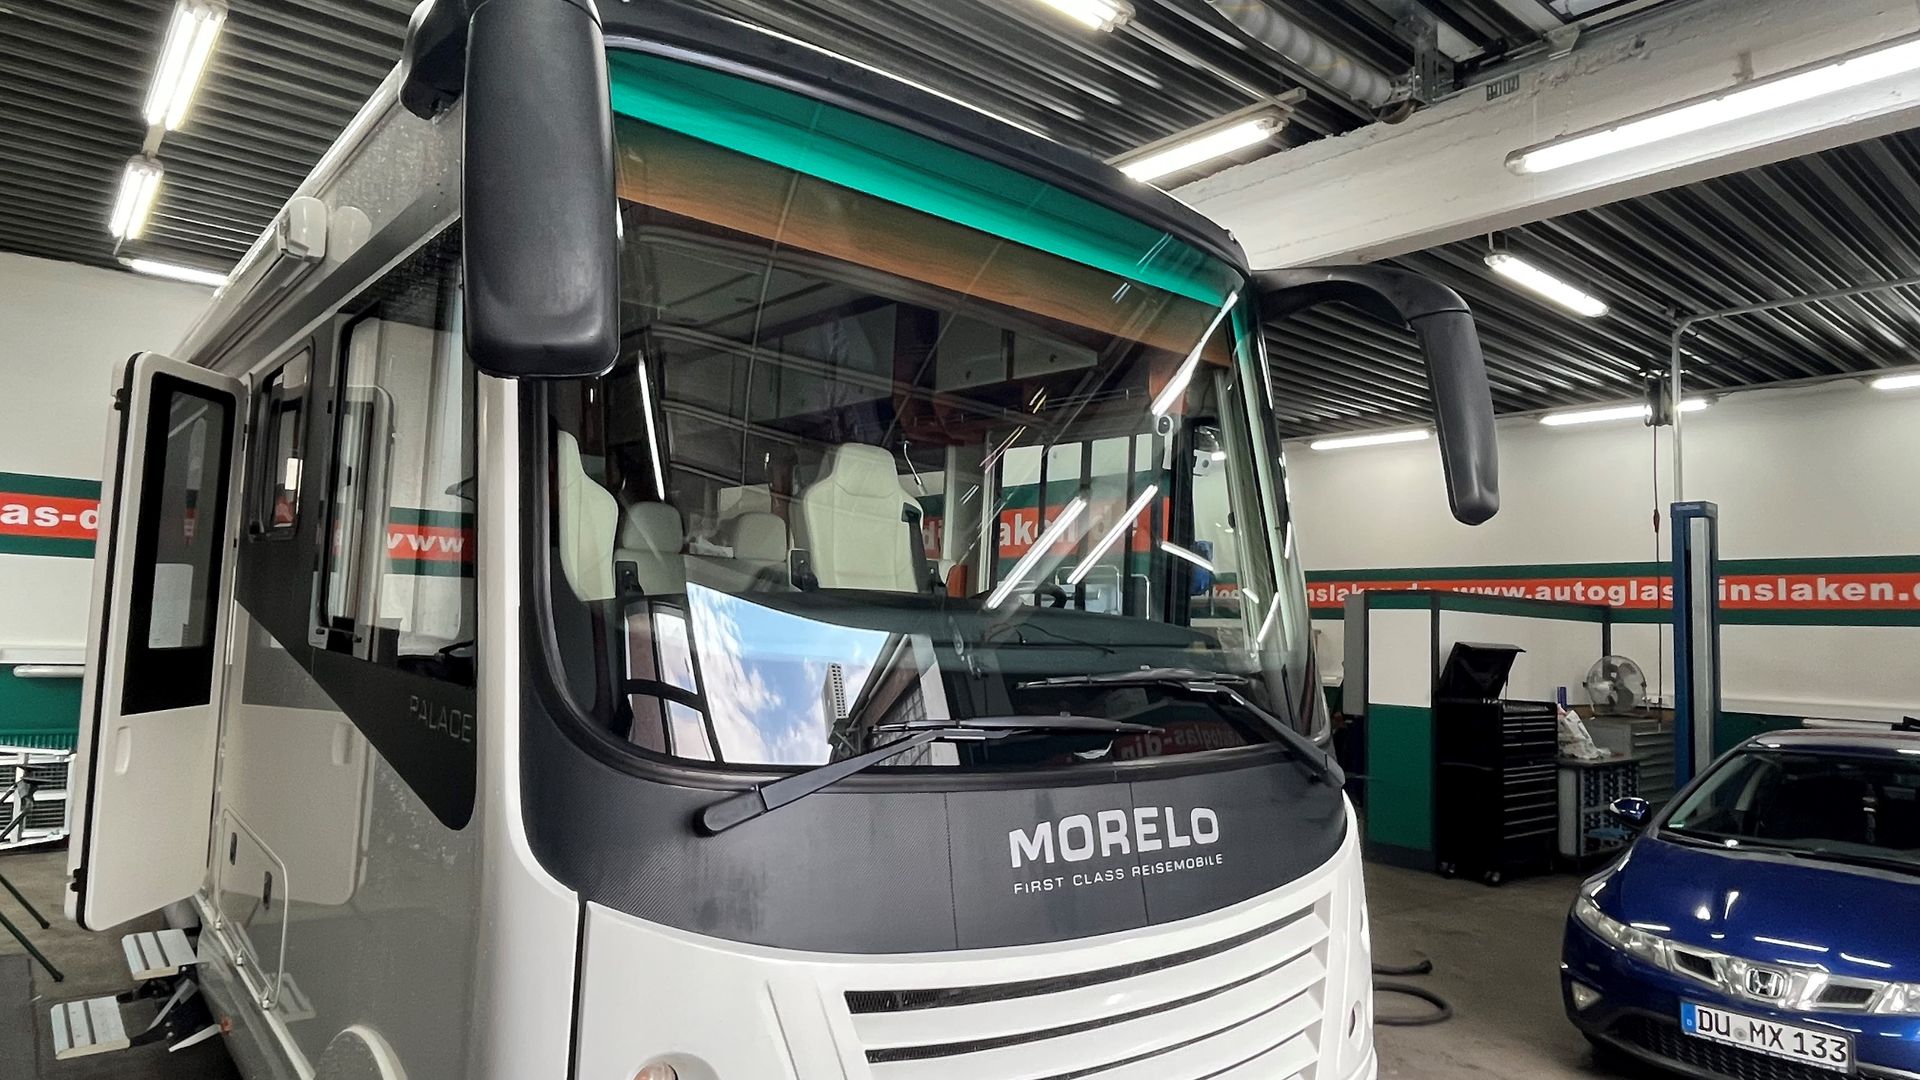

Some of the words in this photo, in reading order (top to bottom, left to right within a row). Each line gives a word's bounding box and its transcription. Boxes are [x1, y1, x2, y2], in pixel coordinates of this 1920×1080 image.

[409, 695, 472, 742] PALACE
[1008, 806, 1220, 868] MORELO
[1014, 877, 1064, 895] FIRST
[1073, 868, 1125, 886] CLASS
[1131, 853, 1223, 877] REISEMOBILE
[1697, 1008, 1730, 1037] DU
[1749, 1021, 1784, 1050] MX
[1793, 1032, 1847, 1063] 133
